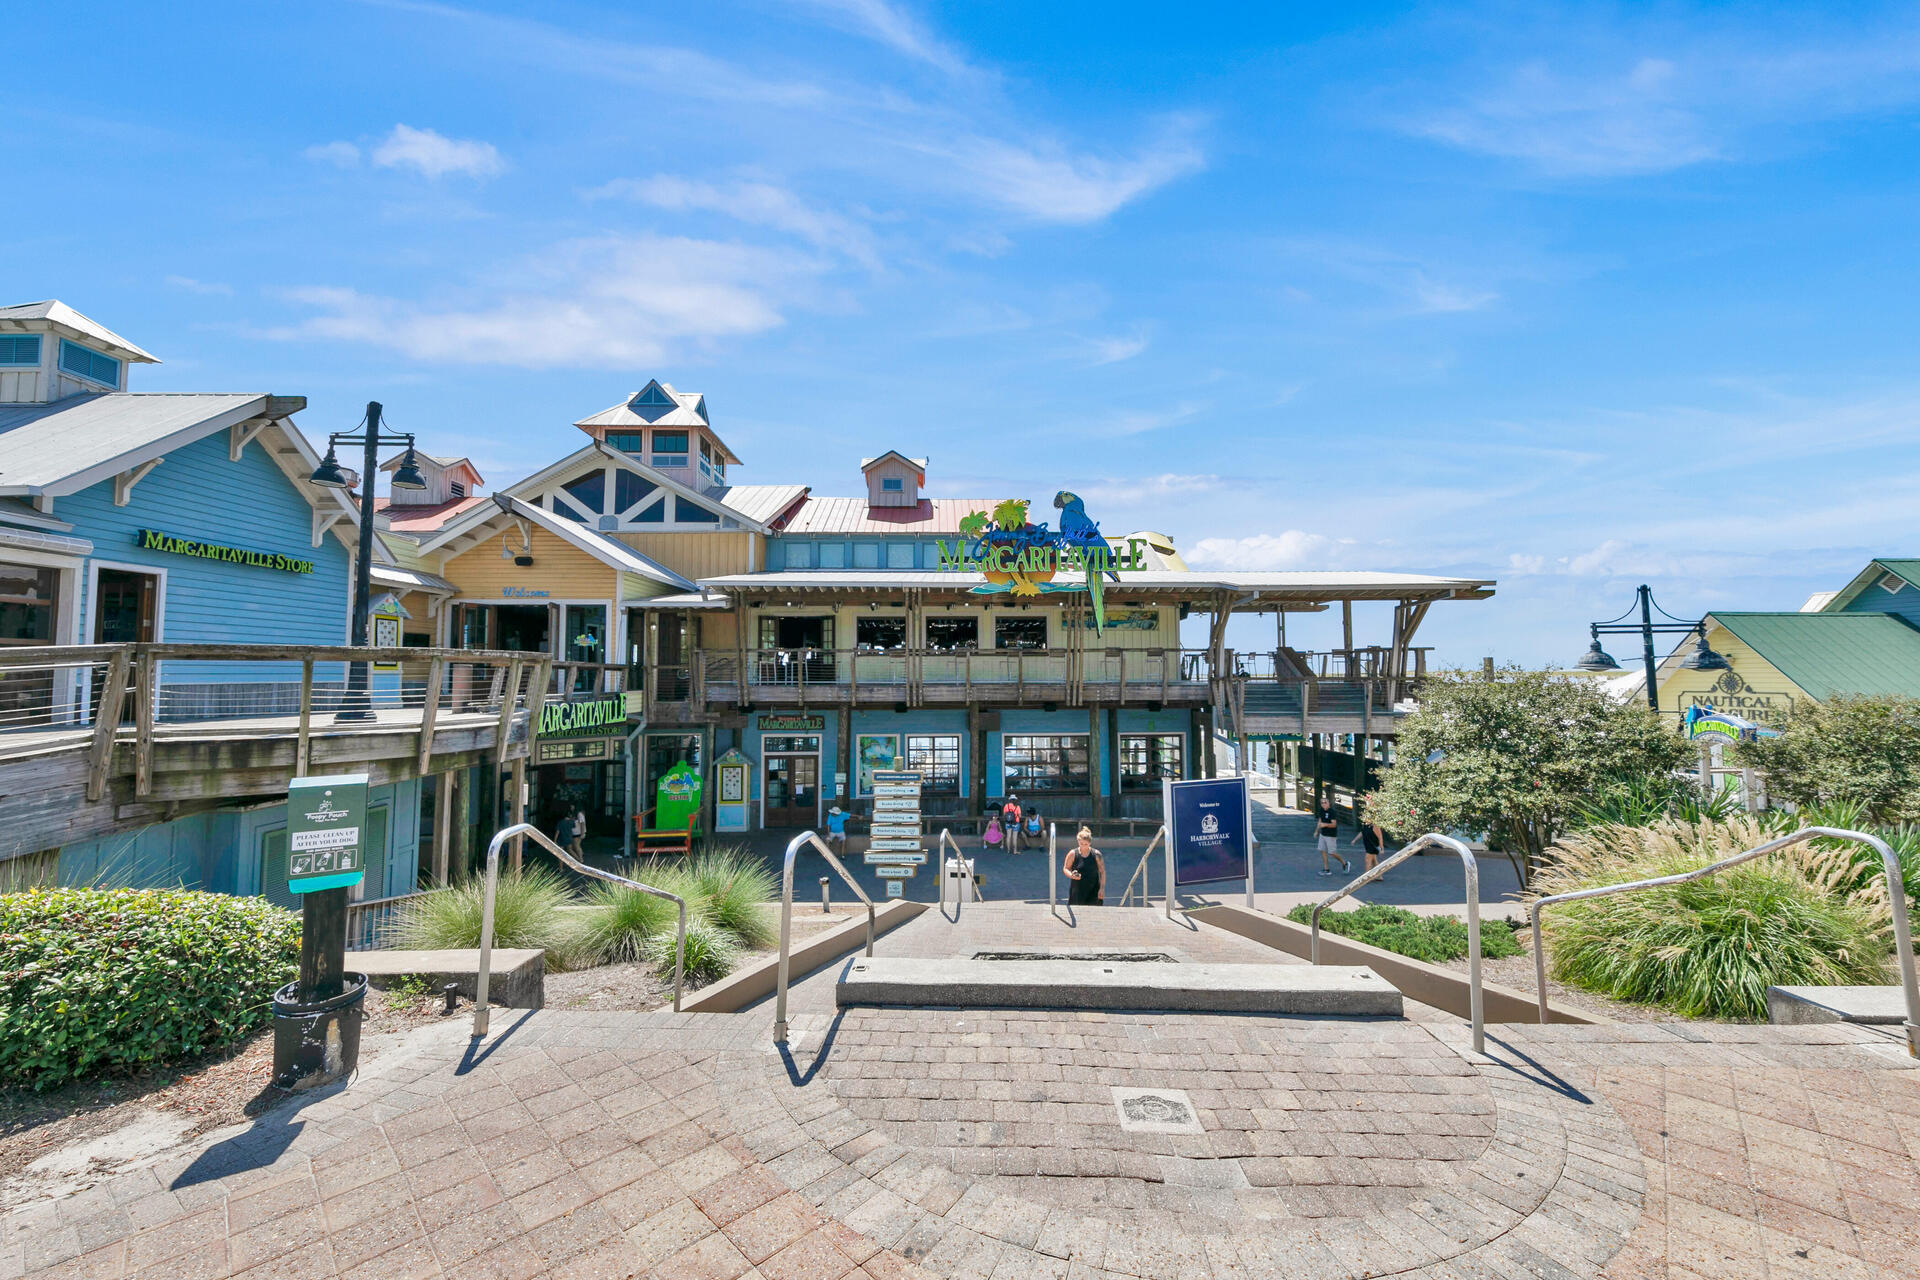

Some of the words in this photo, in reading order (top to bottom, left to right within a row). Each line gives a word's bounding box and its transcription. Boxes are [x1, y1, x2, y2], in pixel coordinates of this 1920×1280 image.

[144, 529, 274, 568] MARGARITAVILLE
[275, 553, 314, 575] STORE
[936, 538, 1147, 573] MARGARITAVILLE
[296, 833, 321, 841] PLEASE
[323, 831, 344, 839] CLEAN
[1190, 832, 1230, 842] HARBORWALK
